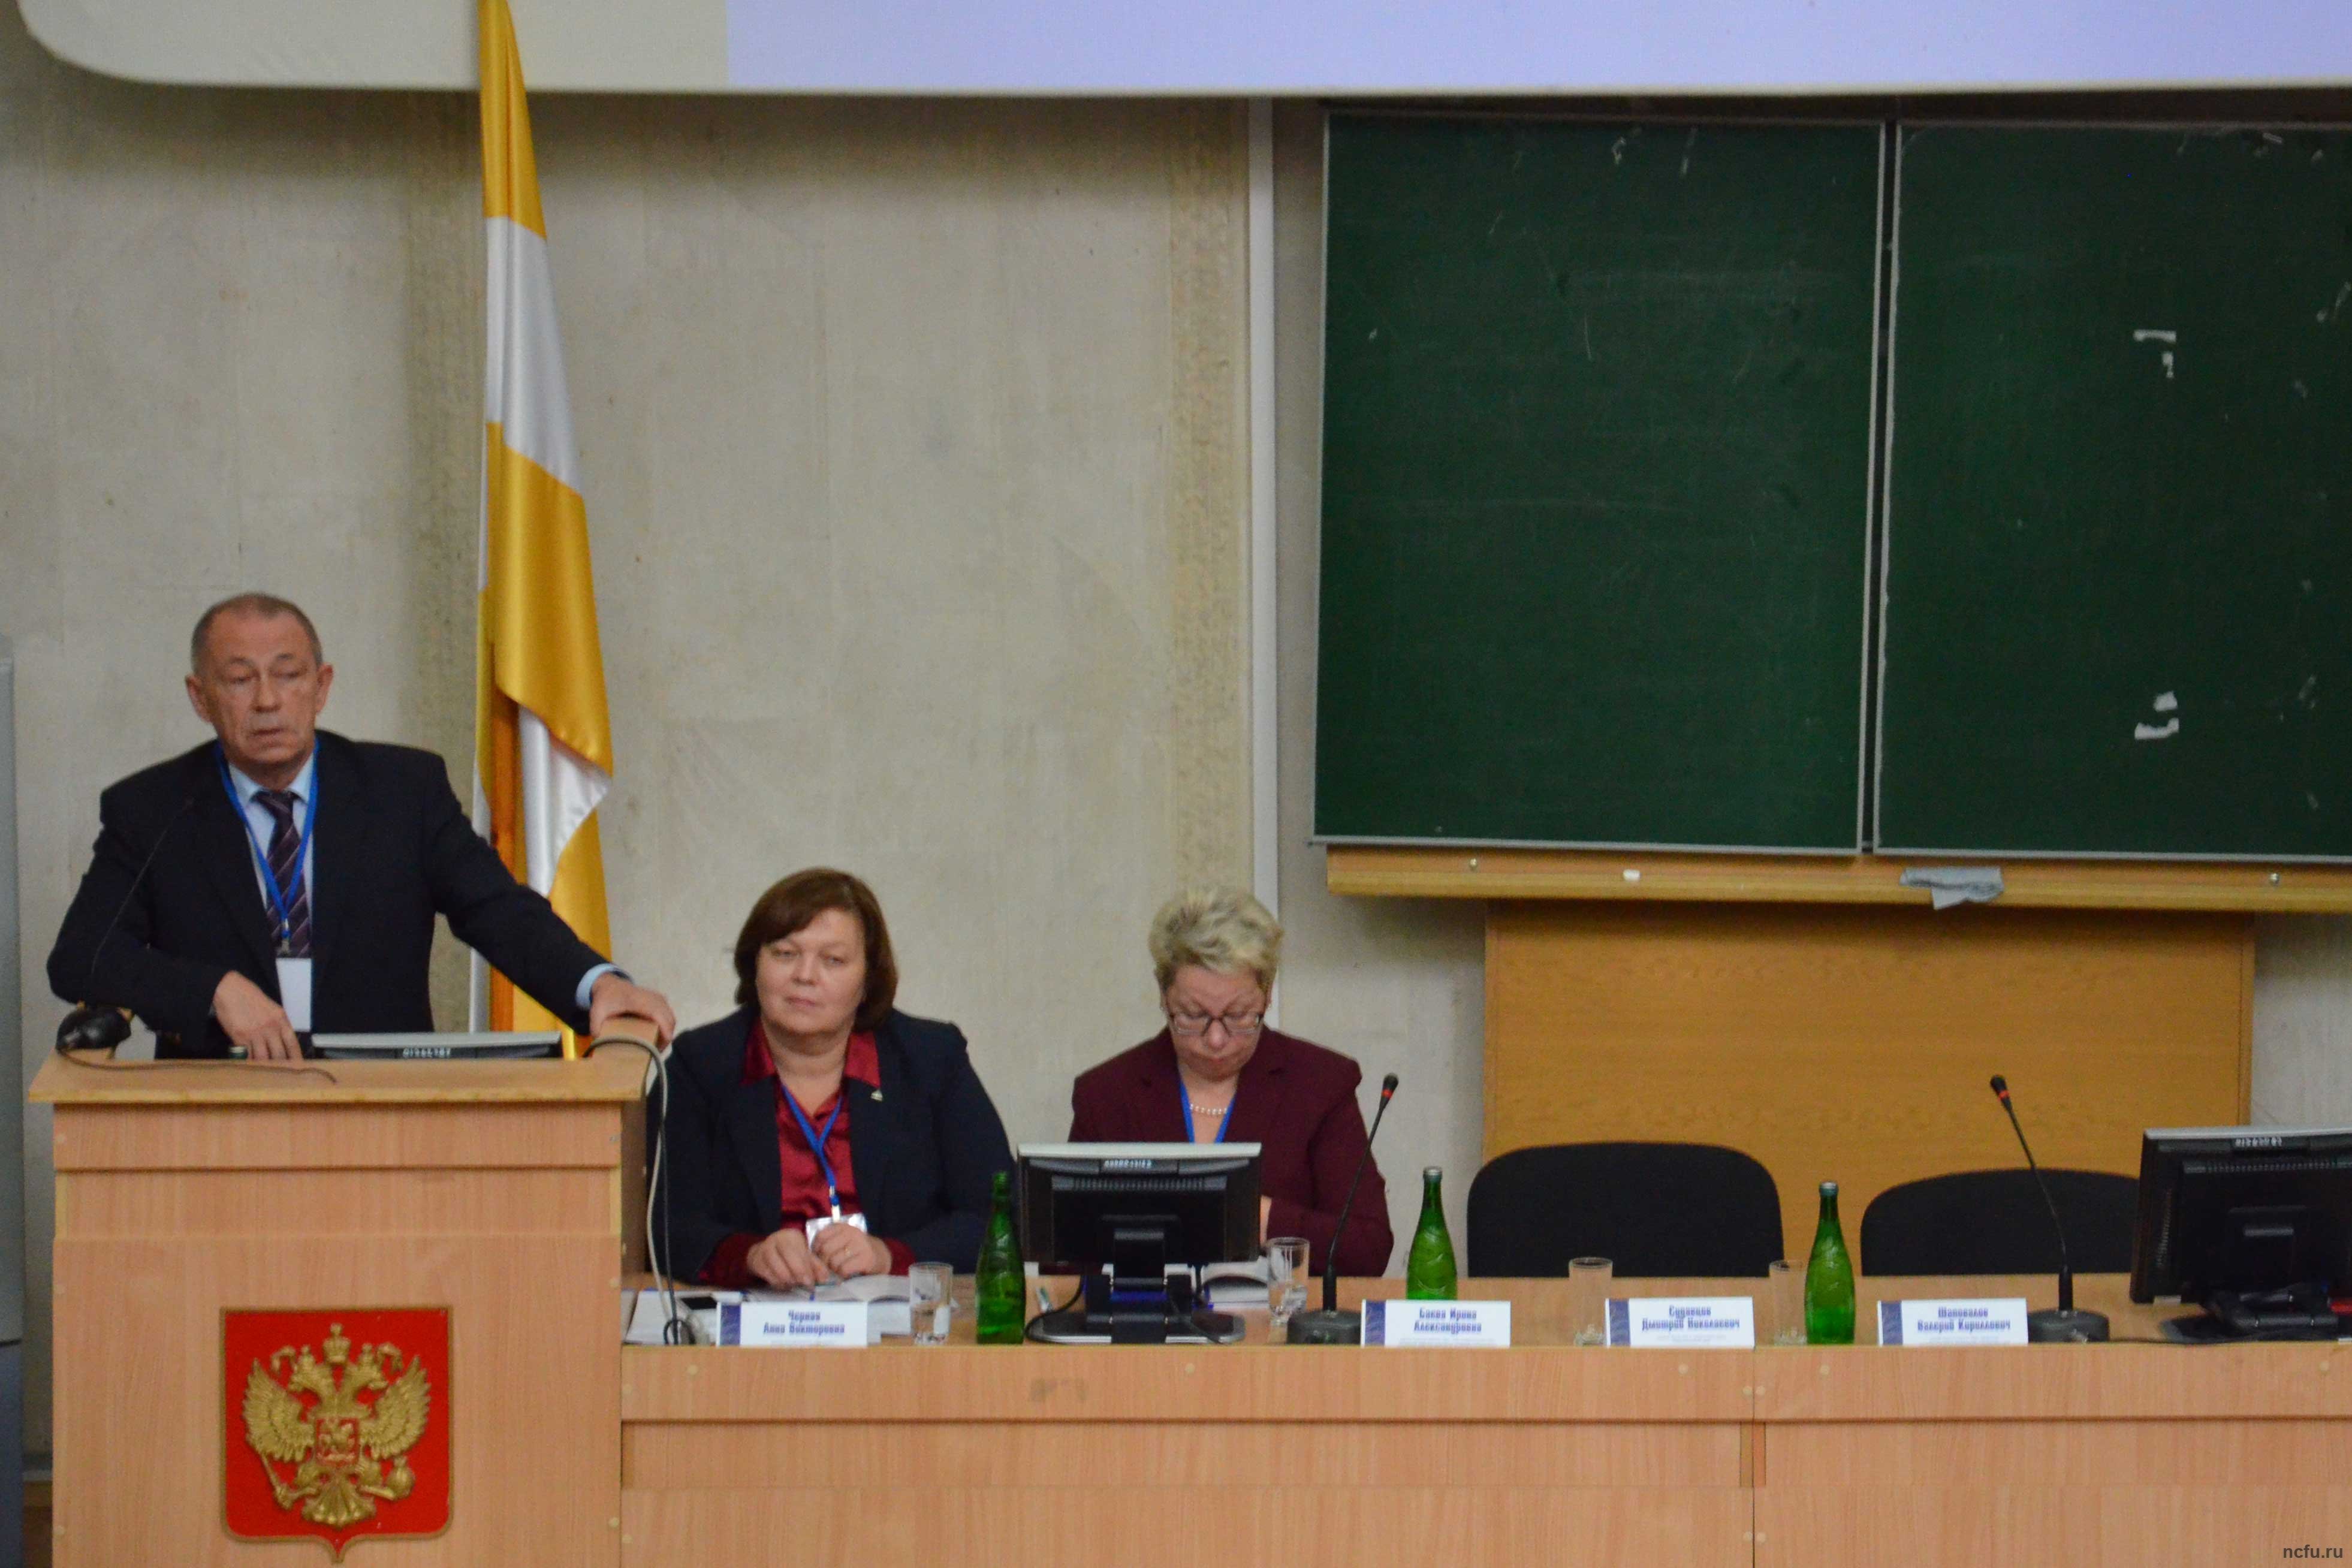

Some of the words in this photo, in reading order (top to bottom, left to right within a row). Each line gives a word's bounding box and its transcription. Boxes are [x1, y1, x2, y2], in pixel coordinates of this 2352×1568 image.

[1450, 1307, 1477, 1320] Ирина
[1938, 1306, 1989, 1318] Шаповалов
[1414, 1320, 1482, 1334] Александровна
[1642, 1317, 1684, 1331] Дмитрий
[1687, 1317, 1741, 1329] Николаевич
[1917, 1319, 1955, 1332] Валерий
[1958, 1318, 2011, 1332] Кириллович
